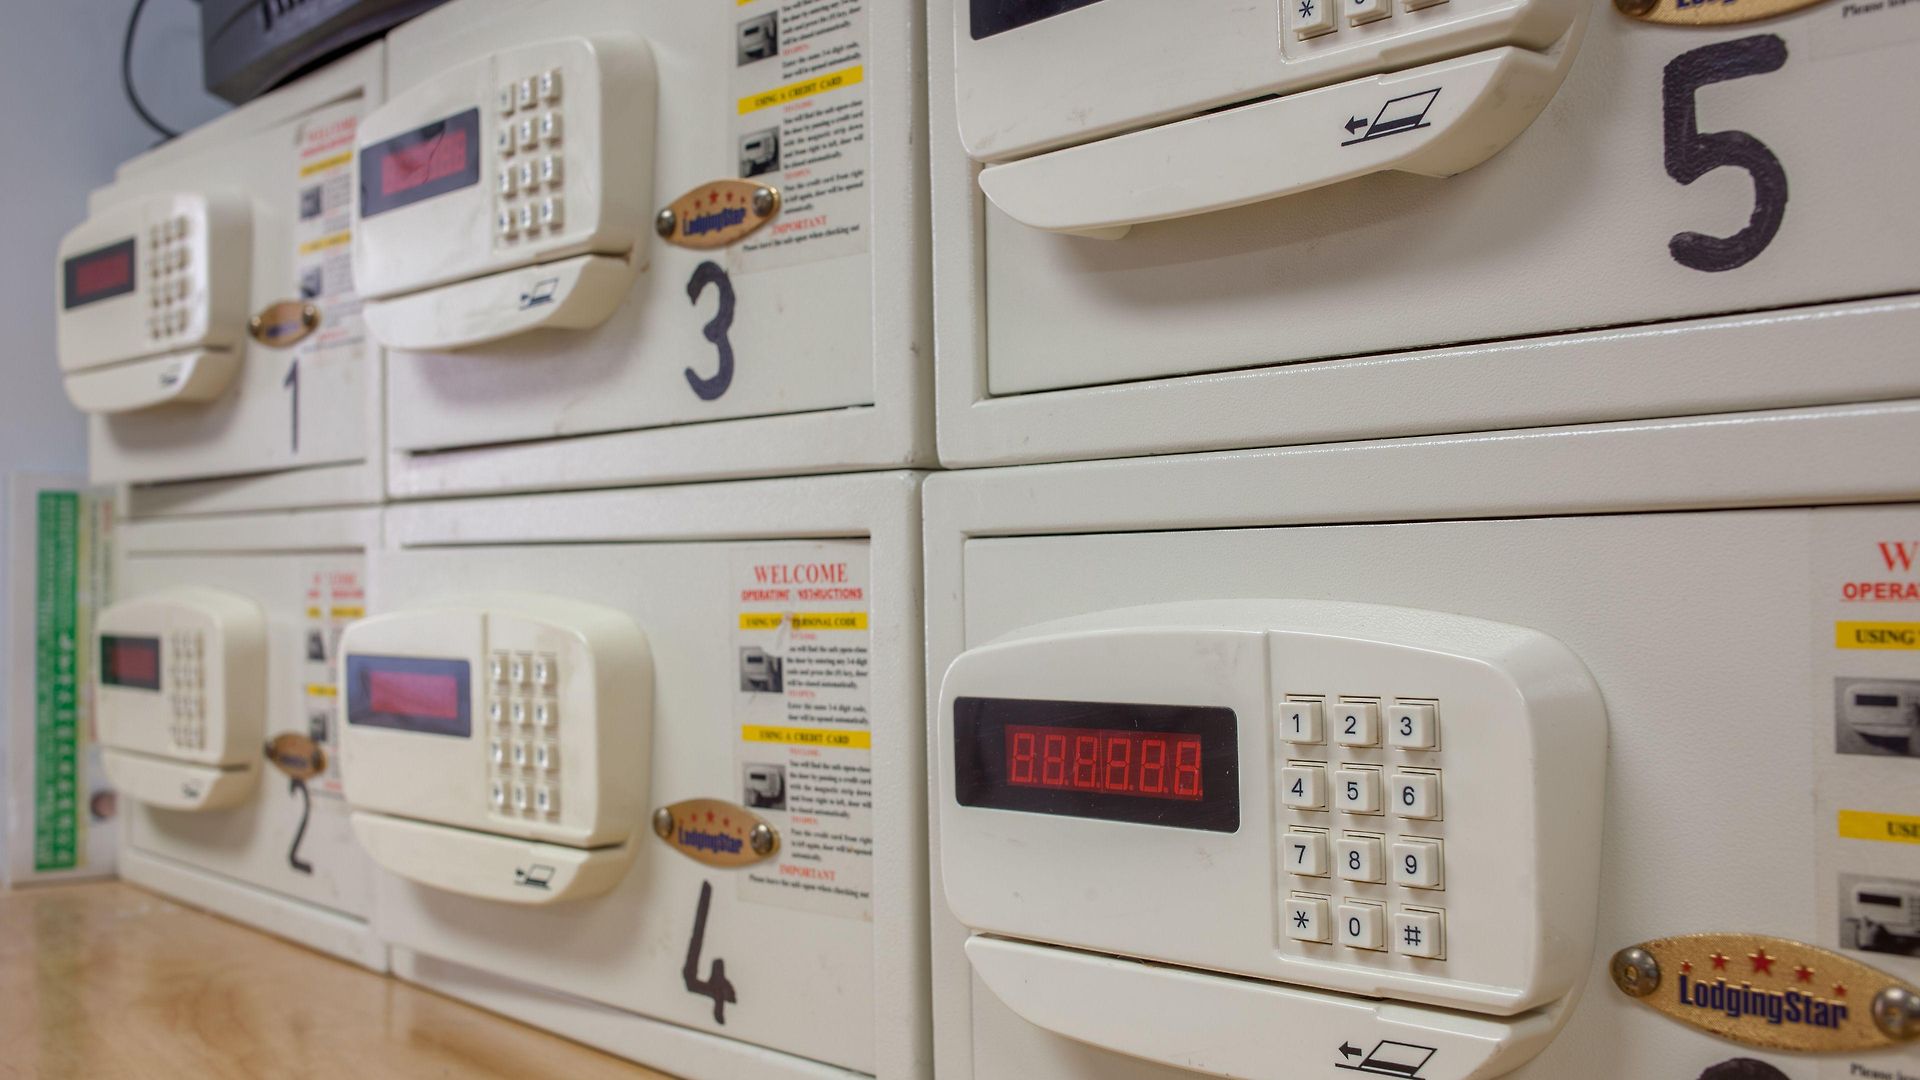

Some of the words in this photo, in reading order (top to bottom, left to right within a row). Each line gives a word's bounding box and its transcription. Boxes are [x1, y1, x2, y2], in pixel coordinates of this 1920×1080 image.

[820, 77, 841, 89] CARD
[1663, 34, 1789, 272] 5
[773, 215, 827, 234] IMPORTANT
[685, 260, 736, 400] 3
[284, 357, 299, 454] 1
[754, 563, 848, 584] WELCOME
[797, 588, 864, 600] NSTRUCTIONS
[834, 617, 856, 626] CODE
[1855, 628, 1916, 646] USING
[1292, 713, 1299, 733] 1
[1344, 715, 1356, 735] 2
[1400, 716, 1412, 736] 3
[794, 732, 823, 743] CREDIT
[826, 735, 850, 744] CARD
[1291, 778, 1303, 797] 4
[1347, 781, 1359, 801] 5
[1402, 786, 1415, 806] 6
[1294, 845, 1306, 864] 7
[1349, 851, 1361, 870] 8
[1405, 855, 1417, 874] 9
[779, 864, 836, 880] IMPORTANT
[1349, 917, 1360, 937] 0
[1404, 925, 1421, 946] #
[683, 880, 737, 1026] 4
[1678, 973, 1848, 1029] LodgingStar
